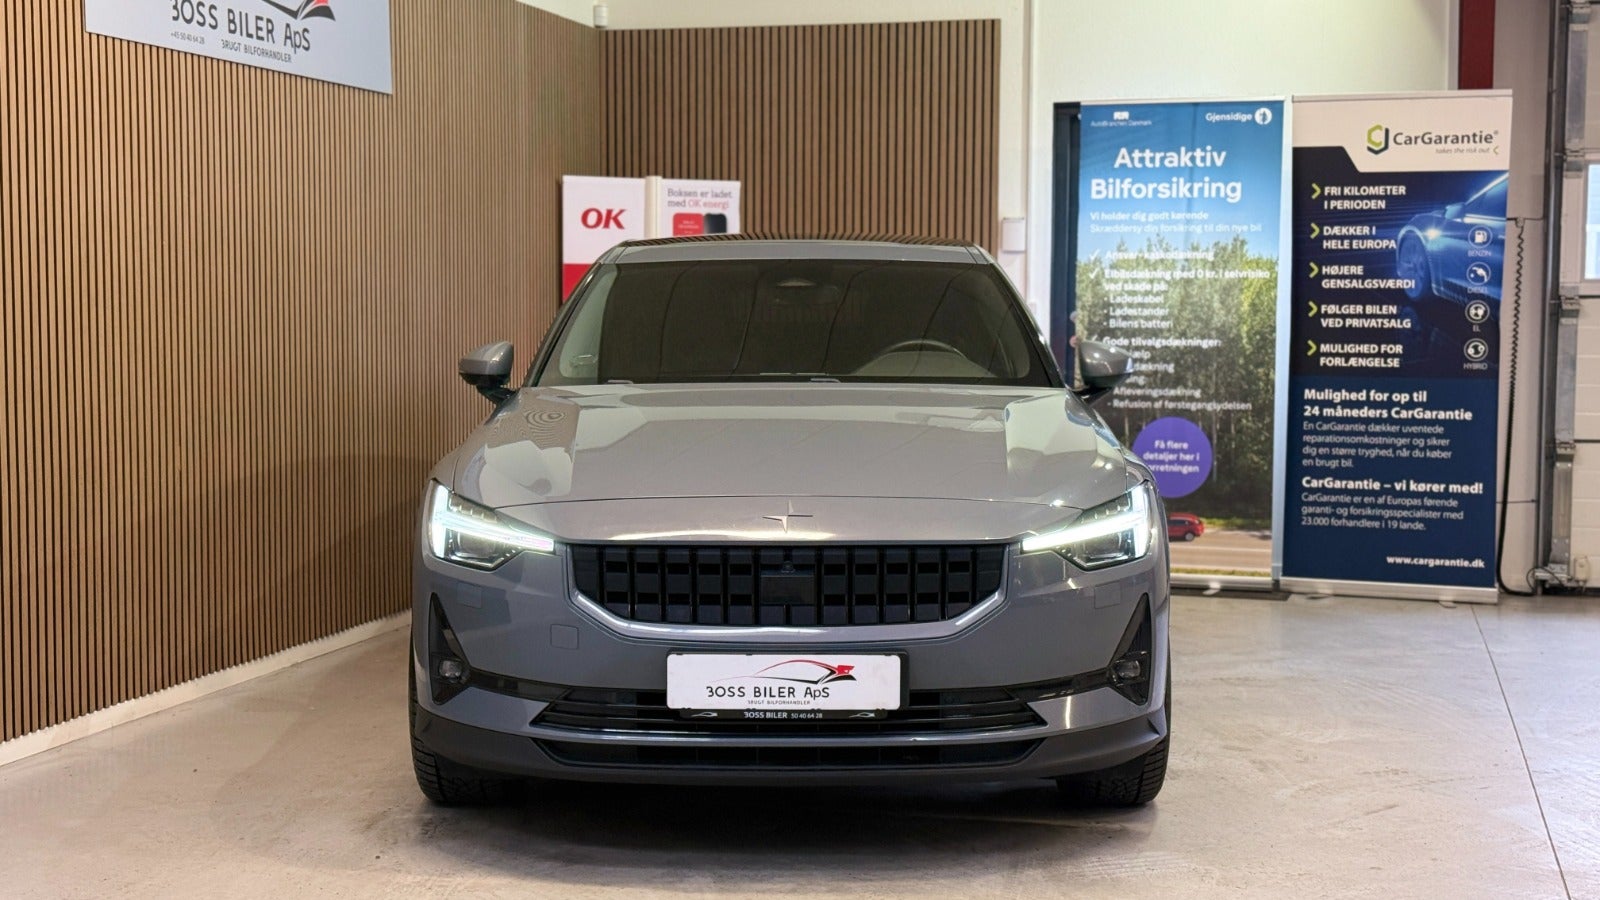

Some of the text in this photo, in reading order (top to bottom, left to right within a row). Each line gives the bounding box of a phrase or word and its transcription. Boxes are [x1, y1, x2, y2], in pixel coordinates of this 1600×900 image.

[228, 9, 275, 43] BILER
[284, 23, 311, 54] ApS
[244, 46, 292, 63] BILFORHANDLER
[1206, 112, 1252, 122] Gjensidige
[1114, 146, 1227, 168] Attraktiv
[668, 188, 698, 198] Boksen
[712, 189, 732, 198] ladet
[1090, 177, 1242, 203] Bilforsikring
[1324, 185, 1406, 196] FRI KILOMETER
[668, 200, 686, 208] med
[702, 200, 729, 211] energi
[1324, 200, 1386, 210] I PERIODEN
[581, 208, 626, 230] OK
[1102, 212, 1130, 220] holder
[1132, 212, 1146, 222] dig
[1148, 212, 1170, 222] godt
[1171, 211, 1208, 220] kørende
[1090, 222, 1262, 234] Skræddersy din forsikring til din nye bil
[1323, 226, 1376, 236] DÆKKER I
[1323, 240, 1397, 250] HELE EUROPA
[1174, 270, 1195, 278] med
[1197, 270, 1203, 278] 0
[1206, 270, 1219, 278] kr.
[1226, 269, 1270, 278] selvrisiko
[1322, 265, 1364, 276] HØJERE
[1104, 282, 1122, 291] ved
[1124, 282, 1151, 291] skade
[1322, 278, 1416, 289] GENSALGSVÆRDI
[1110, 294, 1164, 304] Ladeskabel
[1110, 307, 1169, 316] Ladestander
[1321, 304, 1397, 315] FØLGER BILEN
[1110, 319, 1173, 328] Bilens batteri
[1320, 318, 1412, 328] VED PRIVATSALG
[1473, 324, 1480, 332] EL
[1103, 336, 1129, 346] Gode
[1320, 343, 1403, 354] MULIGHED FOR
[1320, 357, 1400, 368] FORLÆNGELSE
[1464, 362, 1488, 370] HYBRID
[1304, 389, 1427, 404] Mulighed for op til
[1113, 400, 1151, 409] Refusion
[1154, 400, 1162, 409] af
[1304, 405, 1473, 420] 24 måneders CarGarantie
[1303, 422, 1444, 434] En CarGarantie dækker uventede
[1154, 440, 1188, 450] Få flere
[1303, 434, 1450, 446] reparationsomkostninger og sikrer
[1142, 451, 1200, 462] detaljer her i
[1302, 445, 1316, 456] dig
[1332, 447, 1356, 456] større
[1358, 447, 1394, 459] tryghed,
[1396, 448, 1410, 458] når
[1412, 448, 1424, 458] du
[1426, 449, 1452, 459] køber
[1316, 458, 1339, 468] brugt
[1341, 458, 1354, 468] bil.
[1302, 476, 1381, 490] CarGarantie
[1394, 480, 1406, 491] vi
[1410, 480, 1445, 493] kører
[1449, 482, 1484, 494] med!
[1302, 493, 1352, 502] CarGarantie
[1364, 496, 1375, 504] en
[1377, 495, 1386, 504] af
[1387, 496, 1422, 508] Europas
[1424, 497, 1458, 508] førende
[1302, 506, 1464, 520] garanti- og forsikringsspecialister med
[1302, 518, 1330, 526] 23.000
[1331, 518, 1380, 529] forhandlere
[1388, 520, 1398, 530] 19
[1400, 520, 1426, 531] lande.
[1386, 555, 1485, 568] www.cargarantie.dk
[754, 686, 796, 698] BILER
[804, 686, 830, 700] ApS
